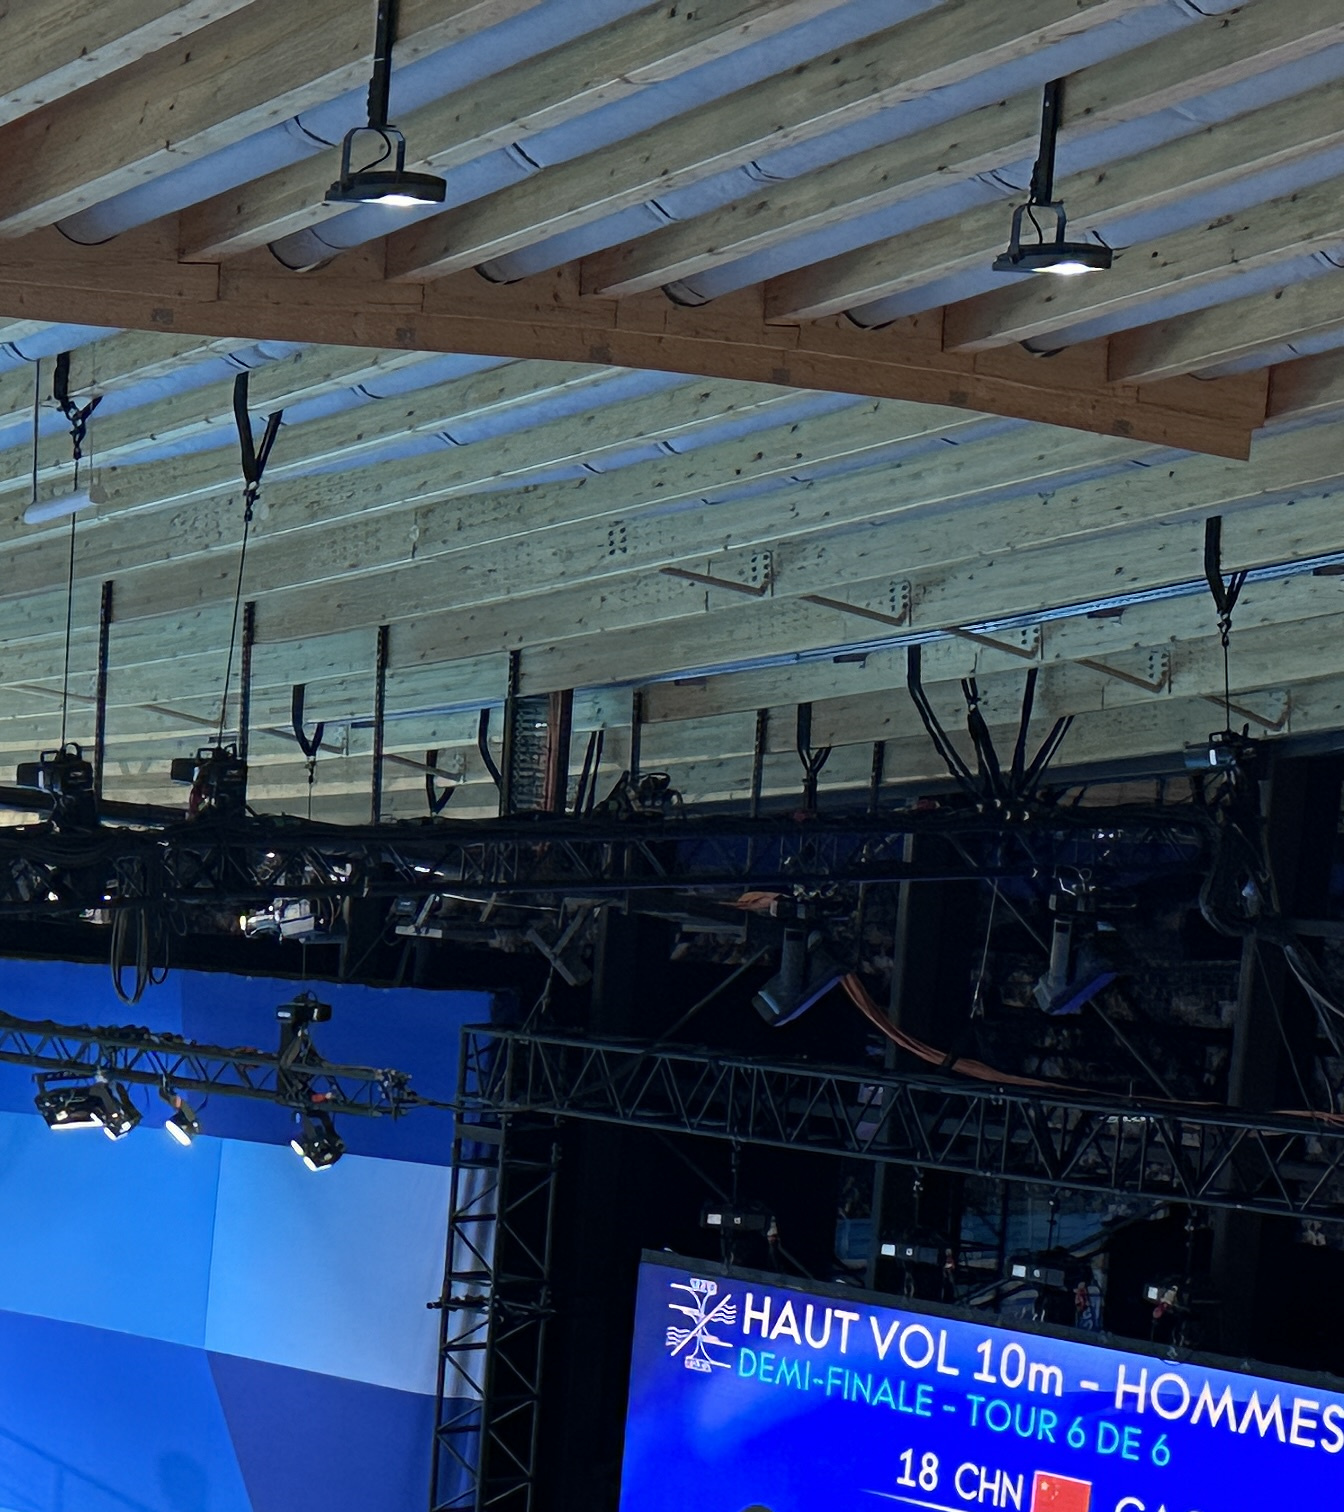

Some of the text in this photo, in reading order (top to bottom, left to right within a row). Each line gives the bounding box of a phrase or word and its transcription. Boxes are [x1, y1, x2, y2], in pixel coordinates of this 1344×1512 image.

[738, 1347, 934, 1417] DEMI-FINALE
[966, 1393, 1056, 1444] TOUR
[1067, 1416, 1086, 1448] 6
[1097, 1421, 1142, 1460] DE
[1151, 1433, 1170, 1466] 6
[743, 1293, 860, 1354] HAUT
[870, 1316, 959, 1376] VOL
[973, 1338, 1063, 1397] 10m
[1115, 1364, 1344, 1453] HOMMES
[896, 1448, 939, 1491] 18
[954, 1462, 1023, 1510] CHN
